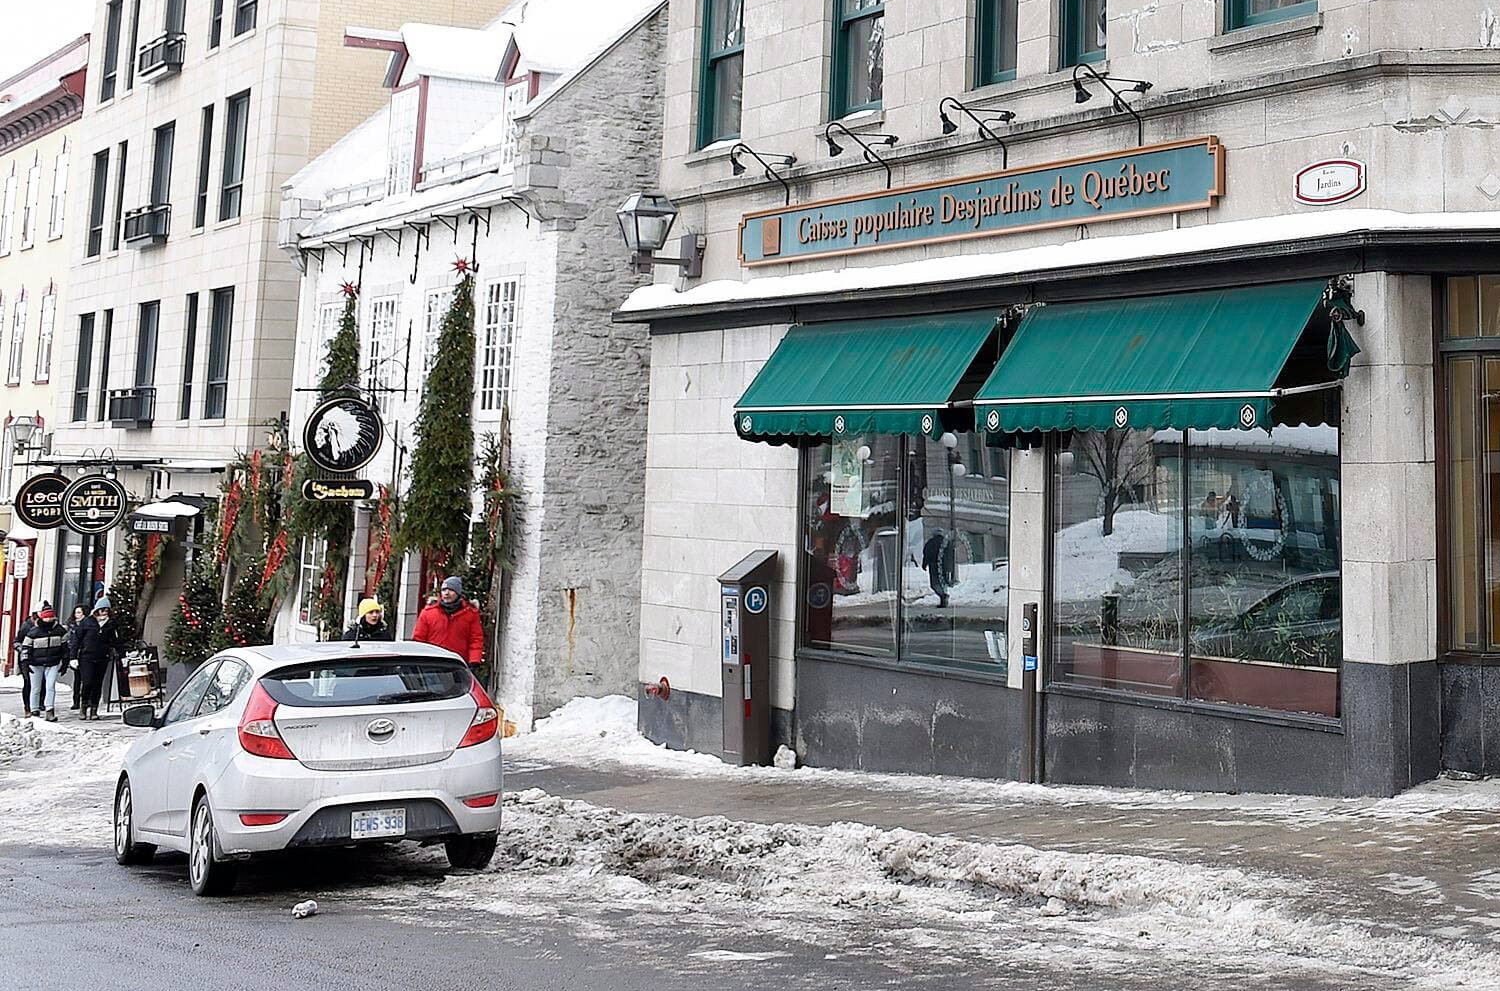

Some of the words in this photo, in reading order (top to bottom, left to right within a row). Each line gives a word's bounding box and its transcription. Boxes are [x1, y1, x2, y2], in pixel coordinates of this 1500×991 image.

[1317, 178, 1342, 192] Jardins
[797, 212, 848, 244] Caisse
[852, 197, 935, 245] populaire
[939, 181, 1042, 228] Desjardins
[1049, 175, 1075, 208] de
[1081, 163, 1171, 209] Québec
[71, 495, 119, 507] SMITH
[31, 508, 61, 517] SPORT
